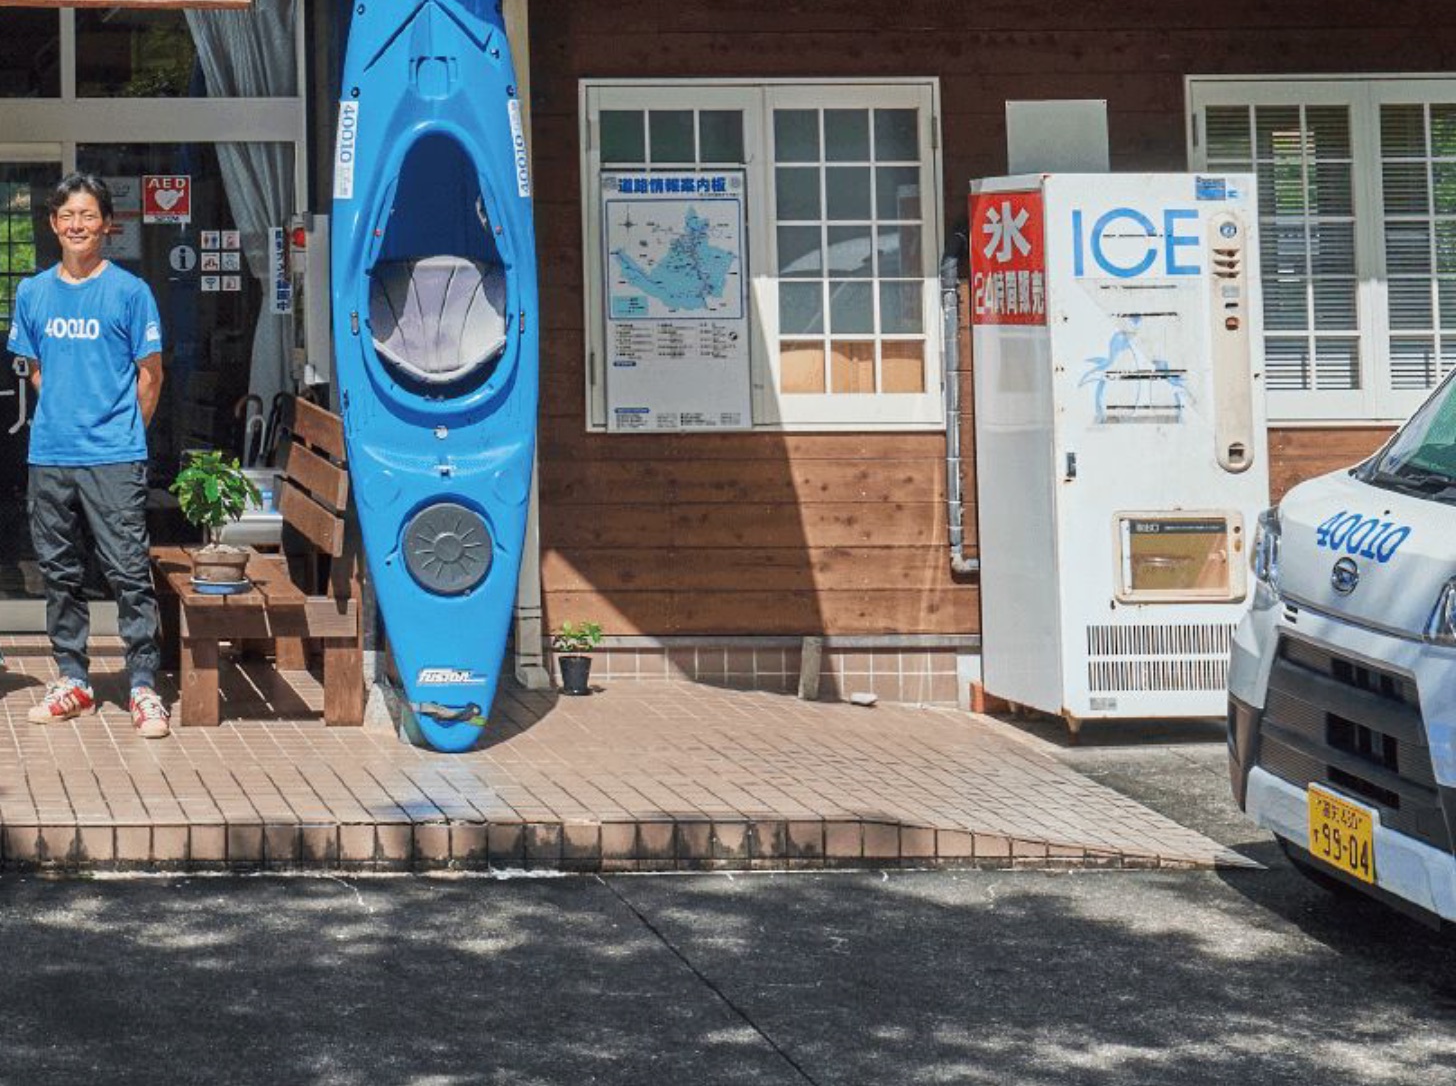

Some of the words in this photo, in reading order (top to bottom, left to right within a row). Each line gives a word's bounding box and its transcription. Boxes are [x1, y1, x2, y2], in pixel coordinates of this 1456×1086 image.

[339, 105, 355, 163] 40010
[148, 178, 187, 189] AED
[618, 177, 726, 194] 道路情報案内板
[982, 201, 1032, 263] 氷
[1071, 207, 1202, 278] ICE
[974, 270, 1045, 315] 24時間販売
[43, 317, 100, 340] 40010
[1317, 511, 1412, 563] 40010
[1322, 822, 1370, 876] 99-04
